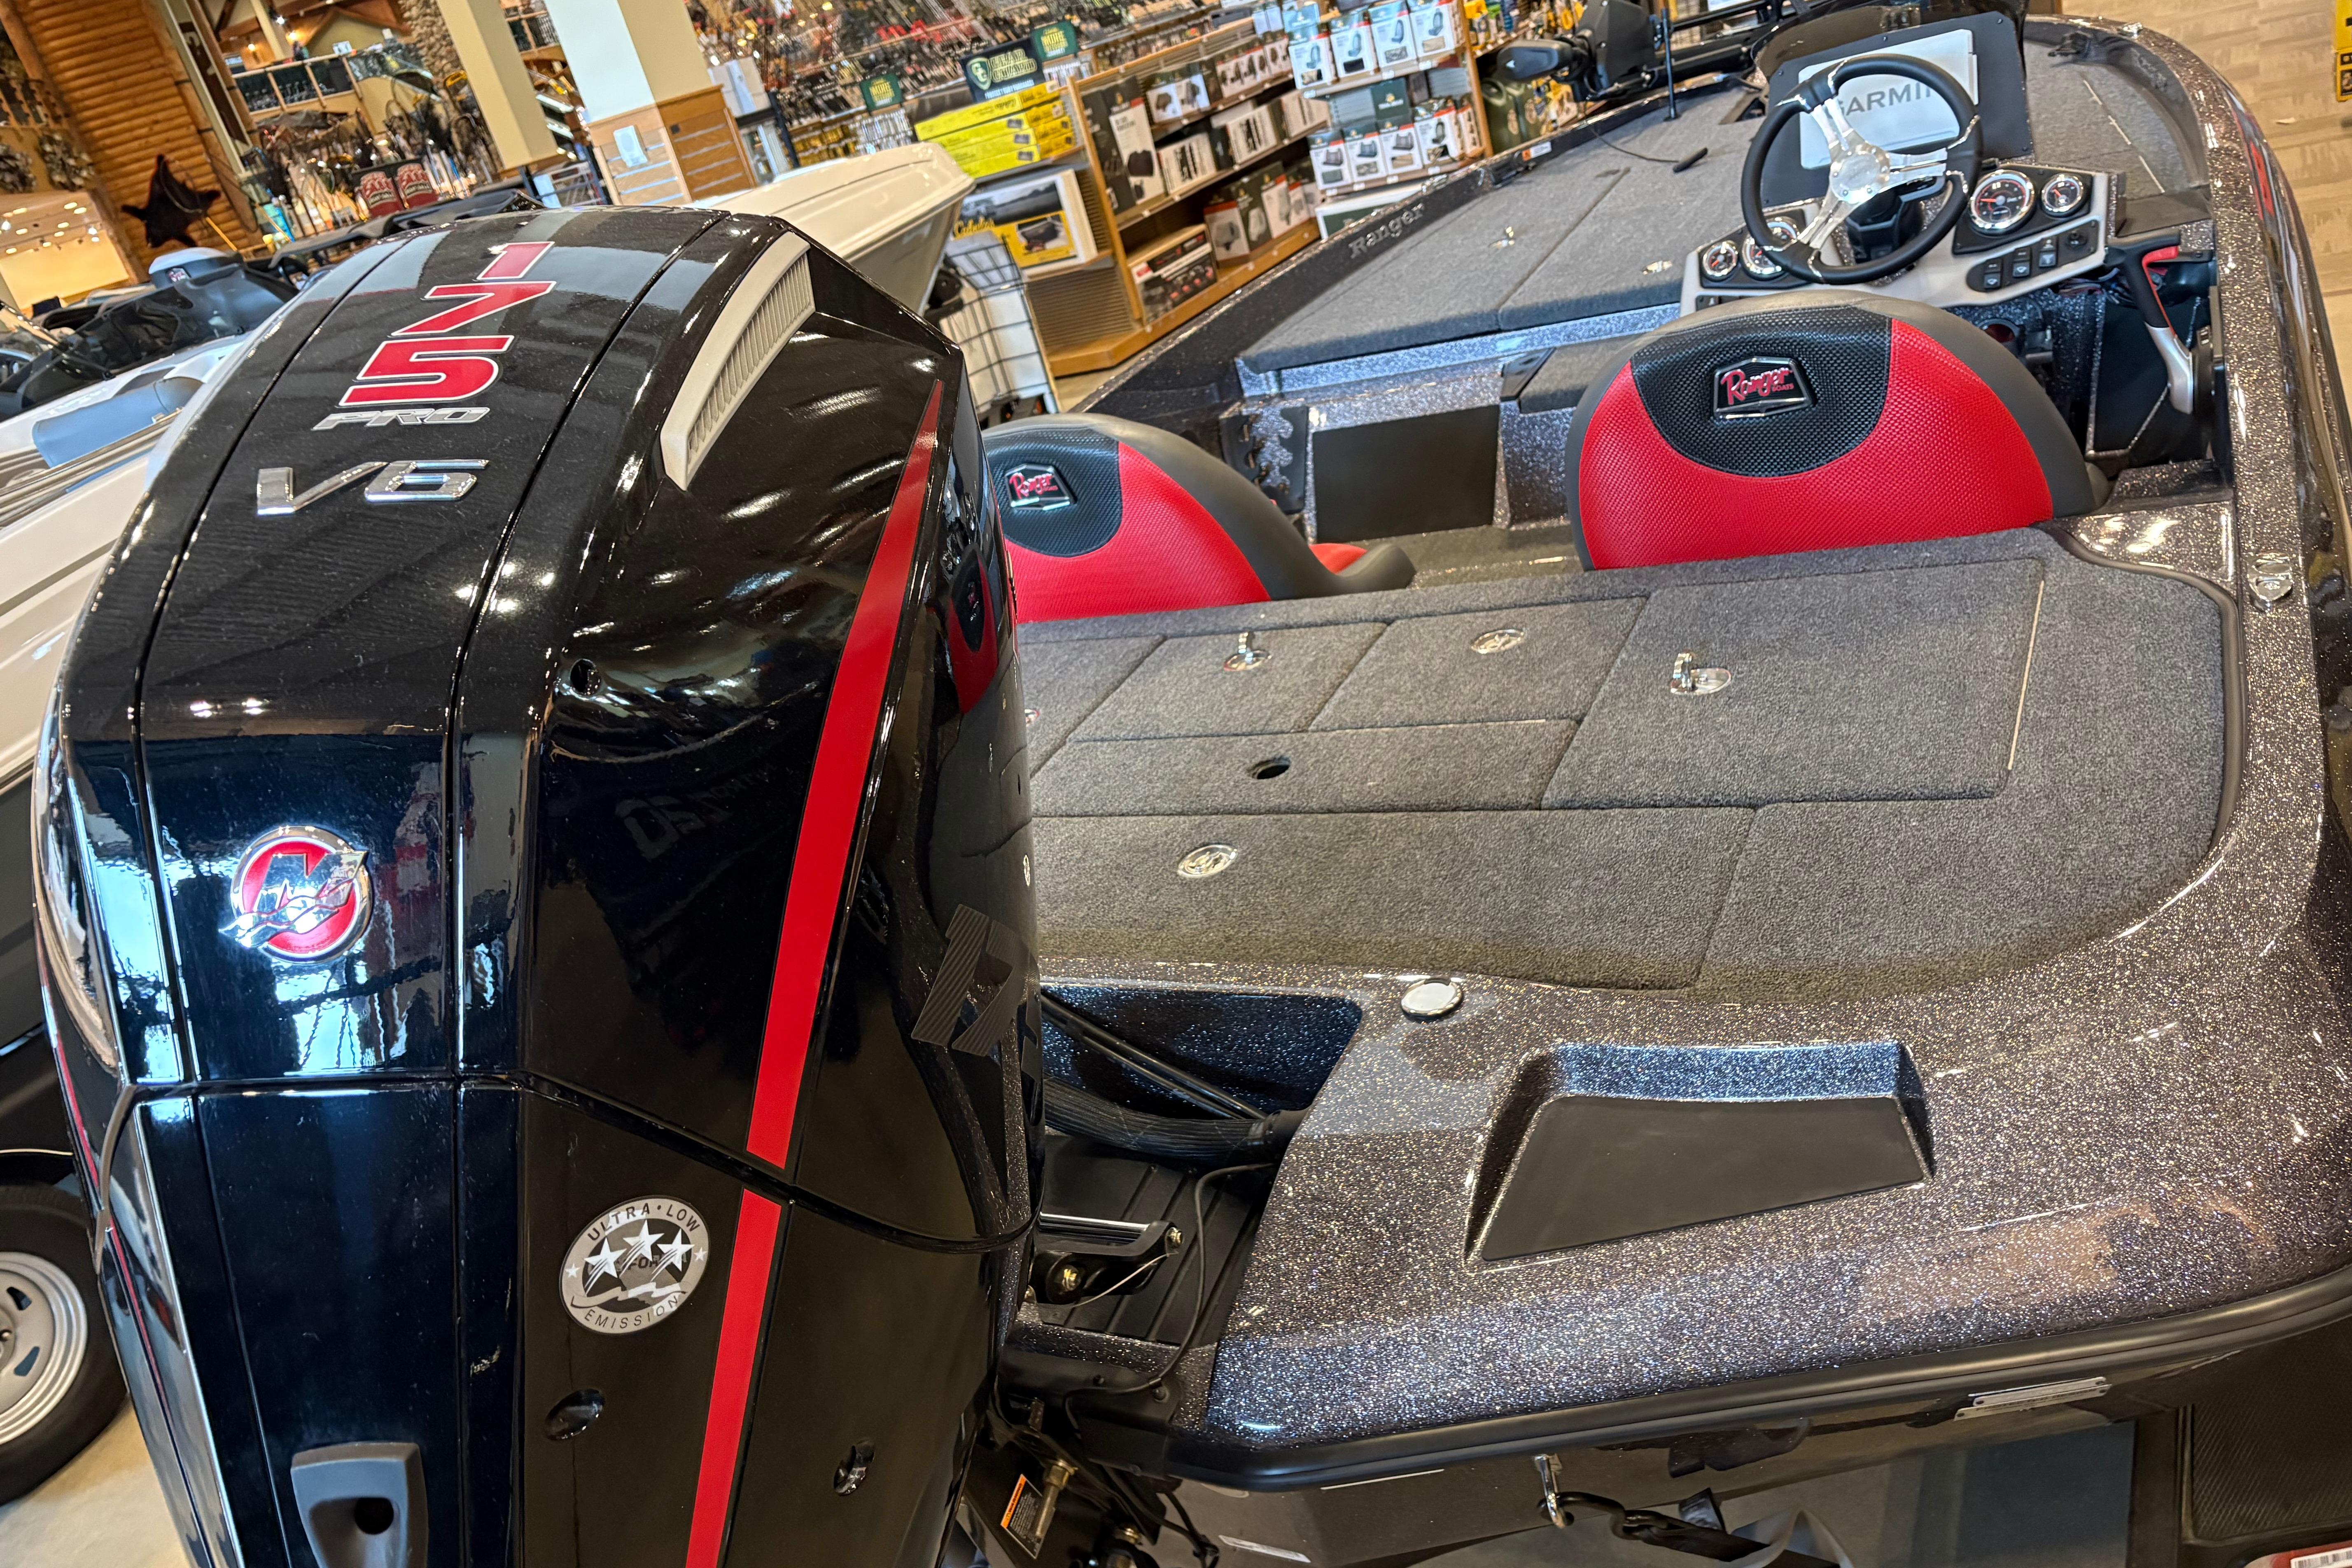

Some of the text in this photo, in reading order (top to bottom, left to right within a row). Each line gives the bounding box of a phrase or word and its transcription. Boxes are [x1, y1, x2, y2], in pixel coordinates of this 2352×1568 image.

[1824, 82, 1931, 119] ARMI
[1348, 202, 1425, 259] Ranger
[1720, 367, 1792, 405] Ranger
[310, 406, 491, 432] PRO
[256, 459, 490, 516] V6
[587, 1202, 700, 1241] ULTRA LOW
[584, 1295, 679, 1329] EMISSION
